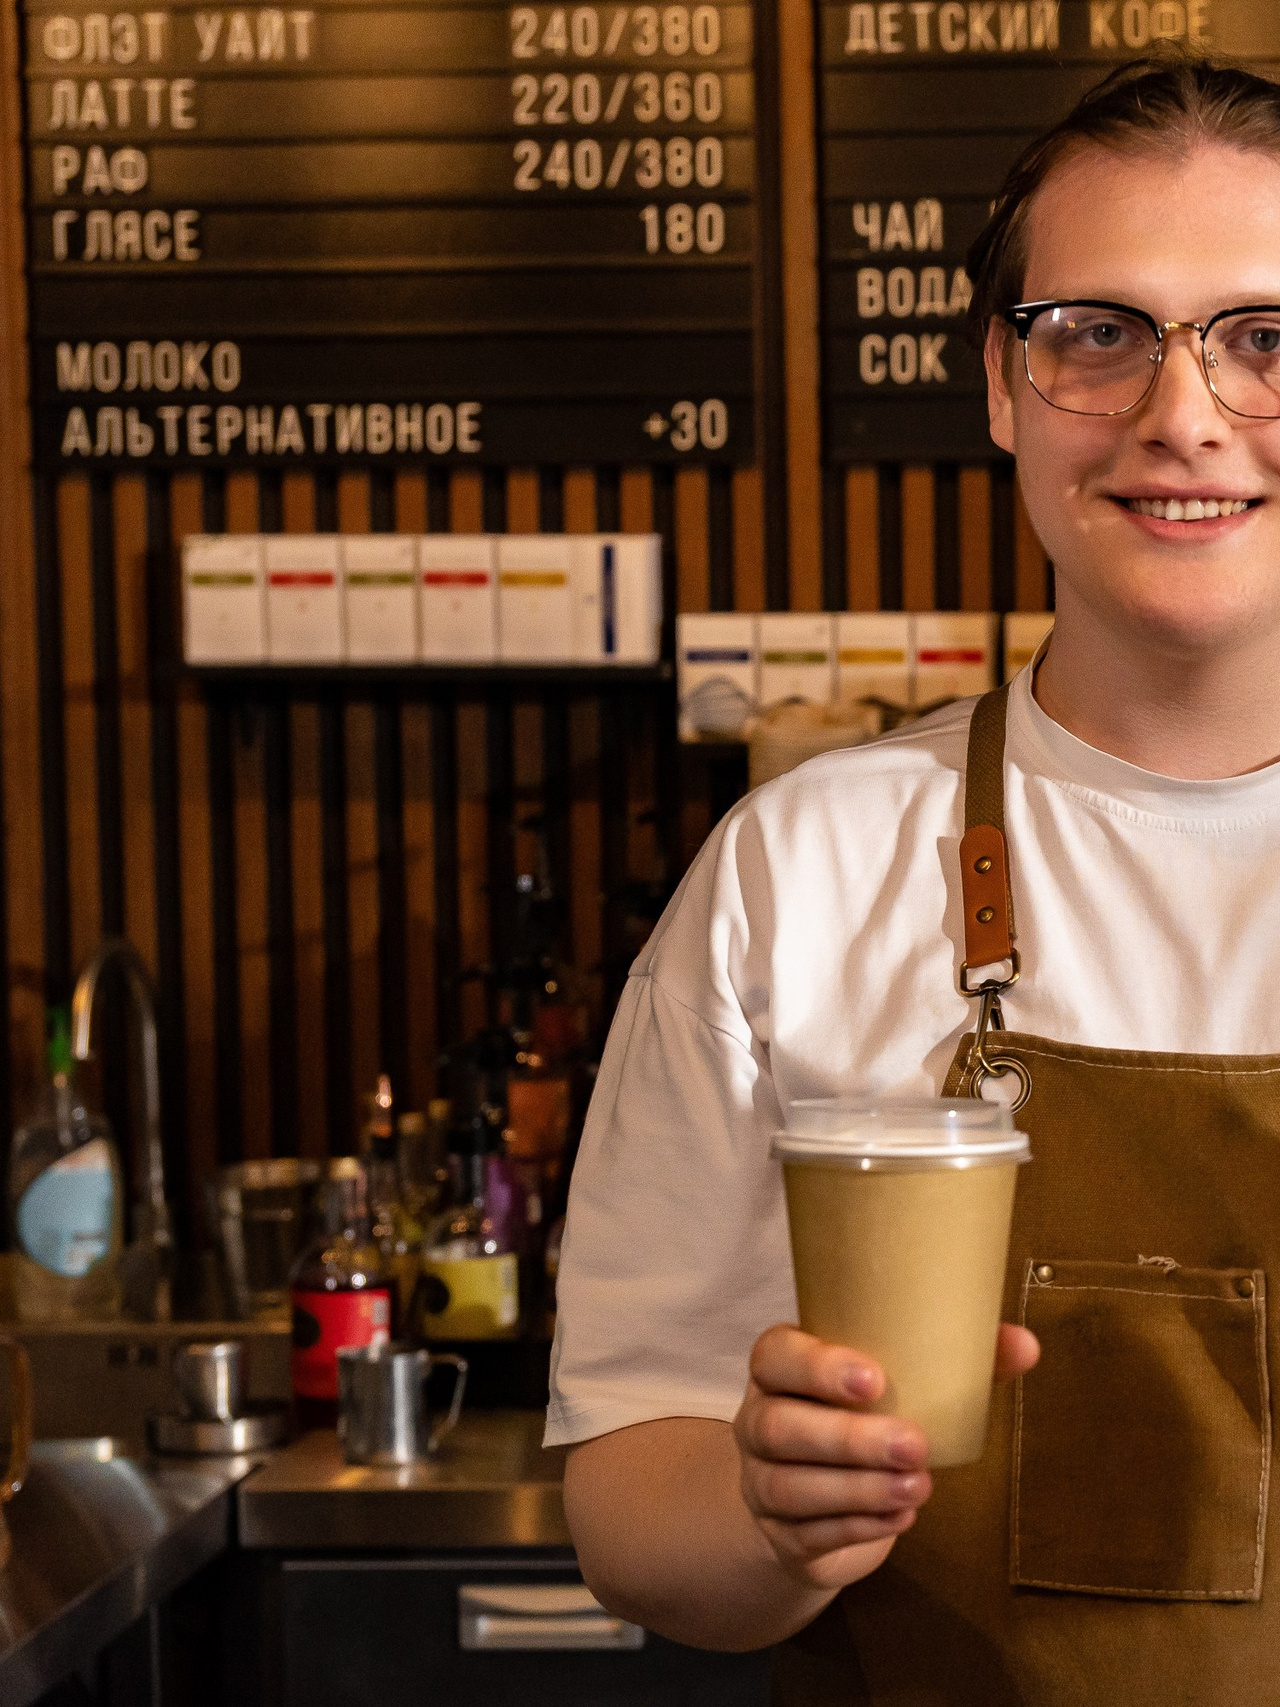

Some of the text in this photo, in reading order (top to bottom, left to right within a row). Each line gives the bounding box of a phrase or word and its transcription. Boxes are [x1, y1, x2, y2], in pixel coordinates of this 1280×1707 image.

[42, 6, 721, 64] ФЛЭТ УАЙТ 240/380
[845, 0, 1060, 54] ДЕТСКИЙ
[1090, 0, 1213, 50] КОФЕ
[49, 72, 722, 131] ЛАТТЕ 220/360
[52, 137, 724, 195] РАФ 240/380
[53, 202, 725, 262] ГЛЯСЕ 180
[852, 198, 944, 252] ЧАЙ
[857, 266, 974, 319] ВОДА
[56, 341, 241, 393] МОЛОКО
[859, 333, 949, 385] СОК
[61, 399, 728, 457] АЛЬТЕРНАТИВНОЕ +30
